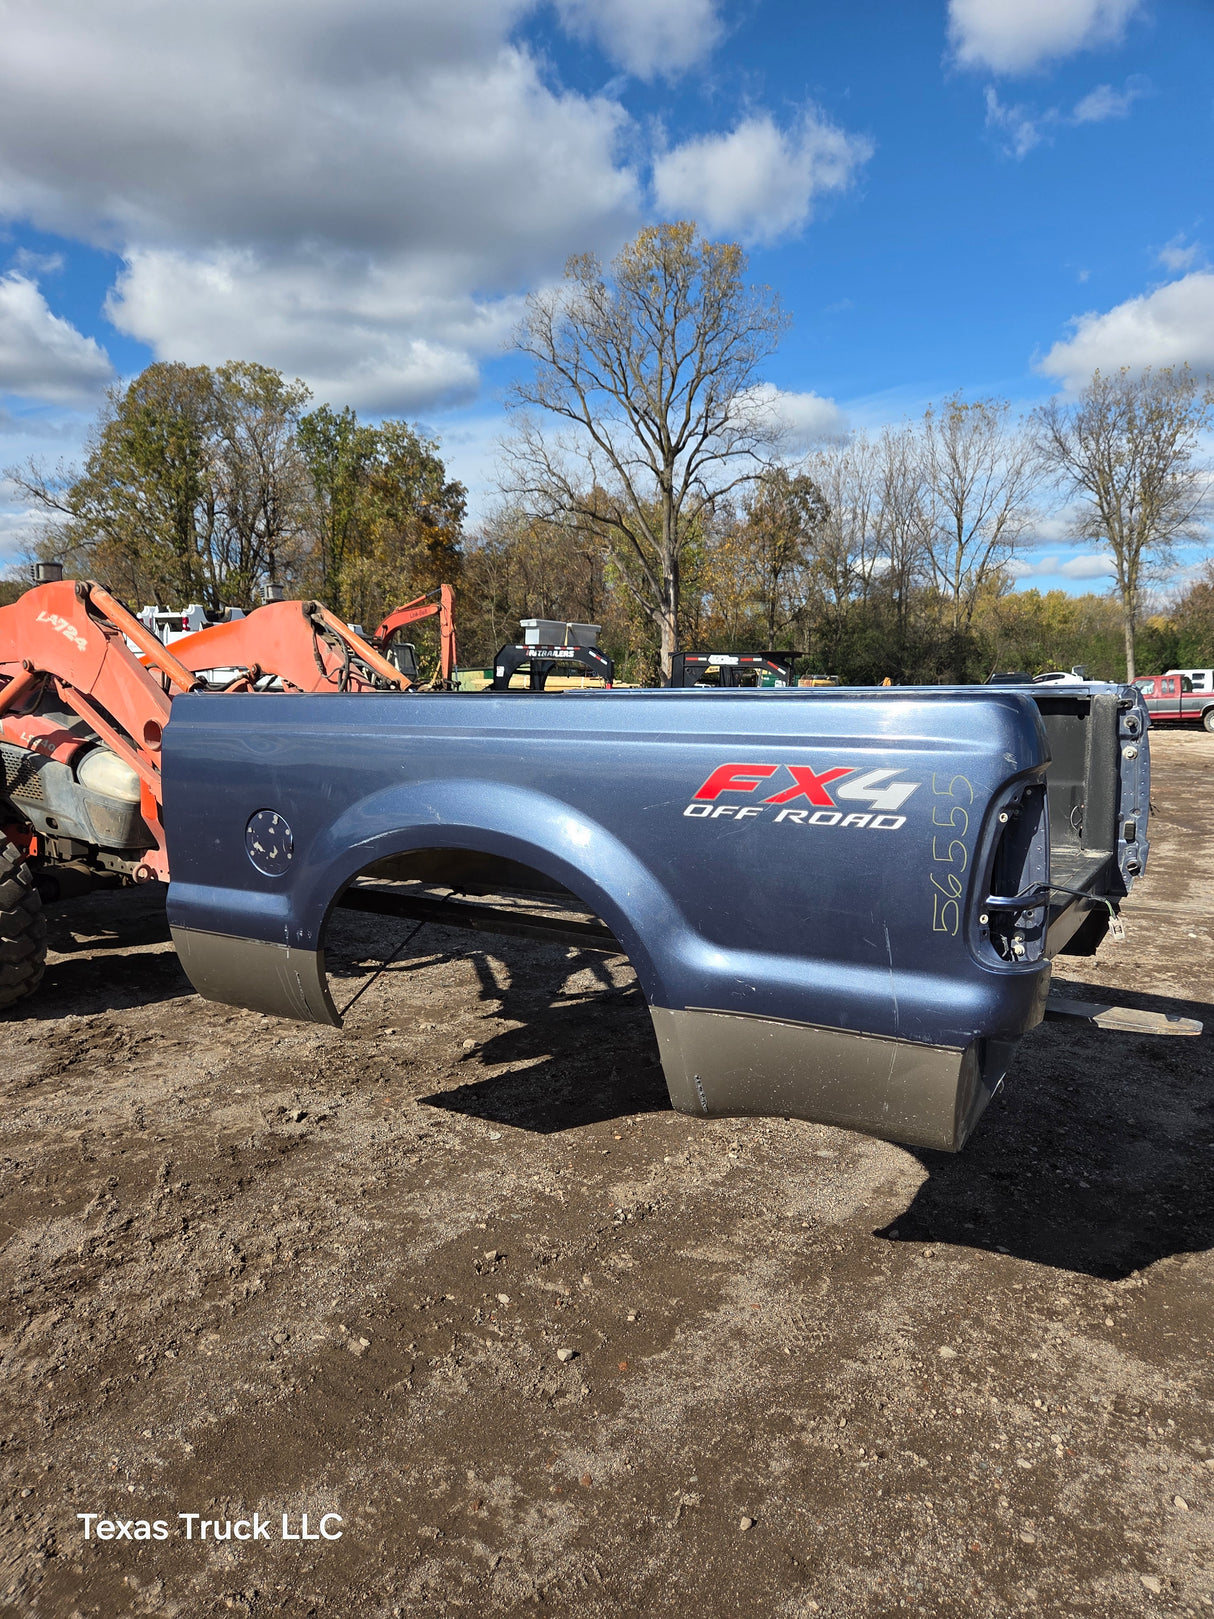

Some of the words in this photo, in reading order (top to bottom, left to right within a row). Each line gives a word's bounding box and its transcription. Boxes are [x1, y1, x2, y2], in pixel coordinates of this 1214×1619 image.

[35, 611, 88, 652] LA724
[537, 650, 575, 658] TRAILERS
[691, 763, 922, 811] FX4
[683, 803, 765, 820] OFF
[773, 808, 907, 830] ROAD
[930, 772, 974, 936] 56555
